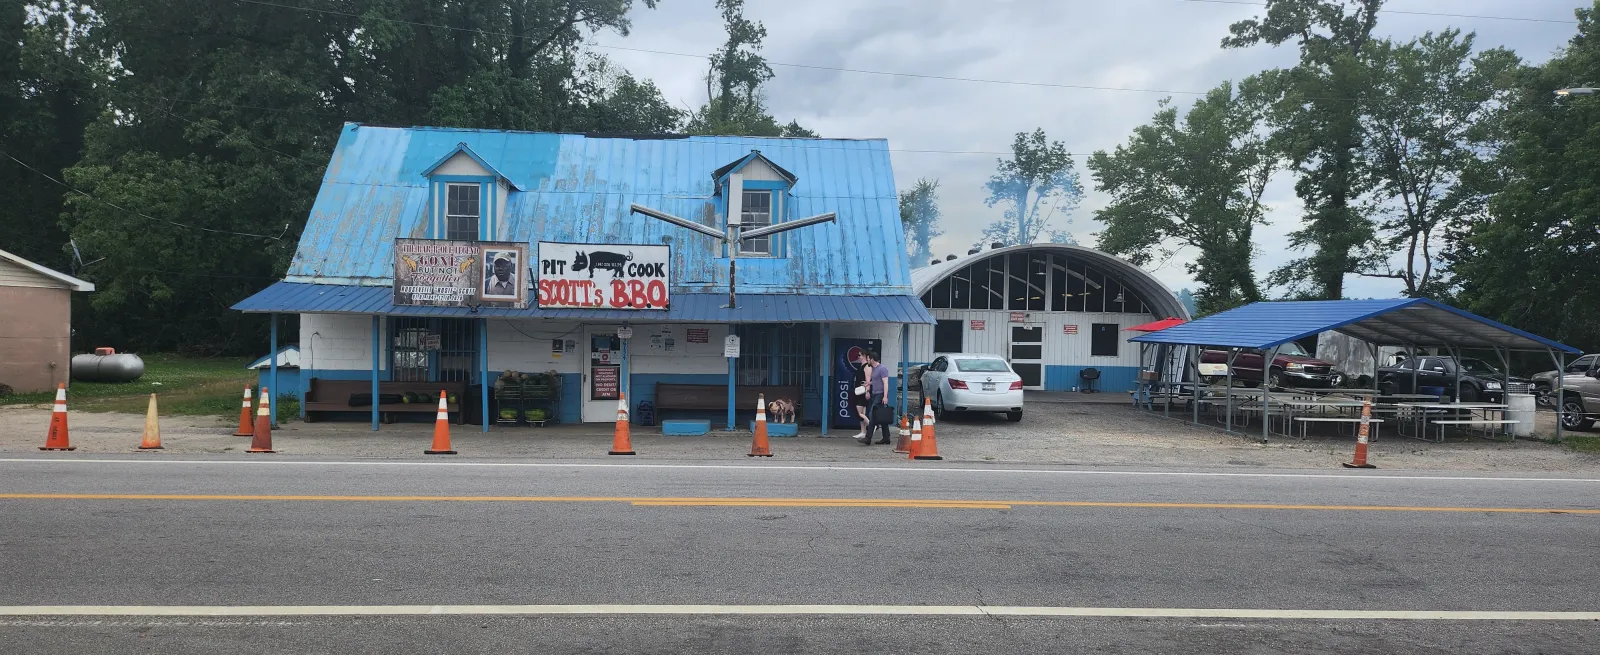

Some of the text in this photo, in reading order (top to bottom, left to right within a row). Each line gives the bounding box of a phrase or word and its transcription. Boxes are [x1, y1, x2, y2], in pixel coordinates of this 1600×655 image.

[402, 244, 417, 253] THE
[455, 246, 479, 255] LEGEND
[420, 255, 457, 267] GONE
[418, 266, 458, 275] BUT NOT
[541, 260, 567, 275] PIT
[627, 262, 666, 278] COOK
[411, 272, 461, 284] Forgotten
[838, 380, 850, 417] pepsi
